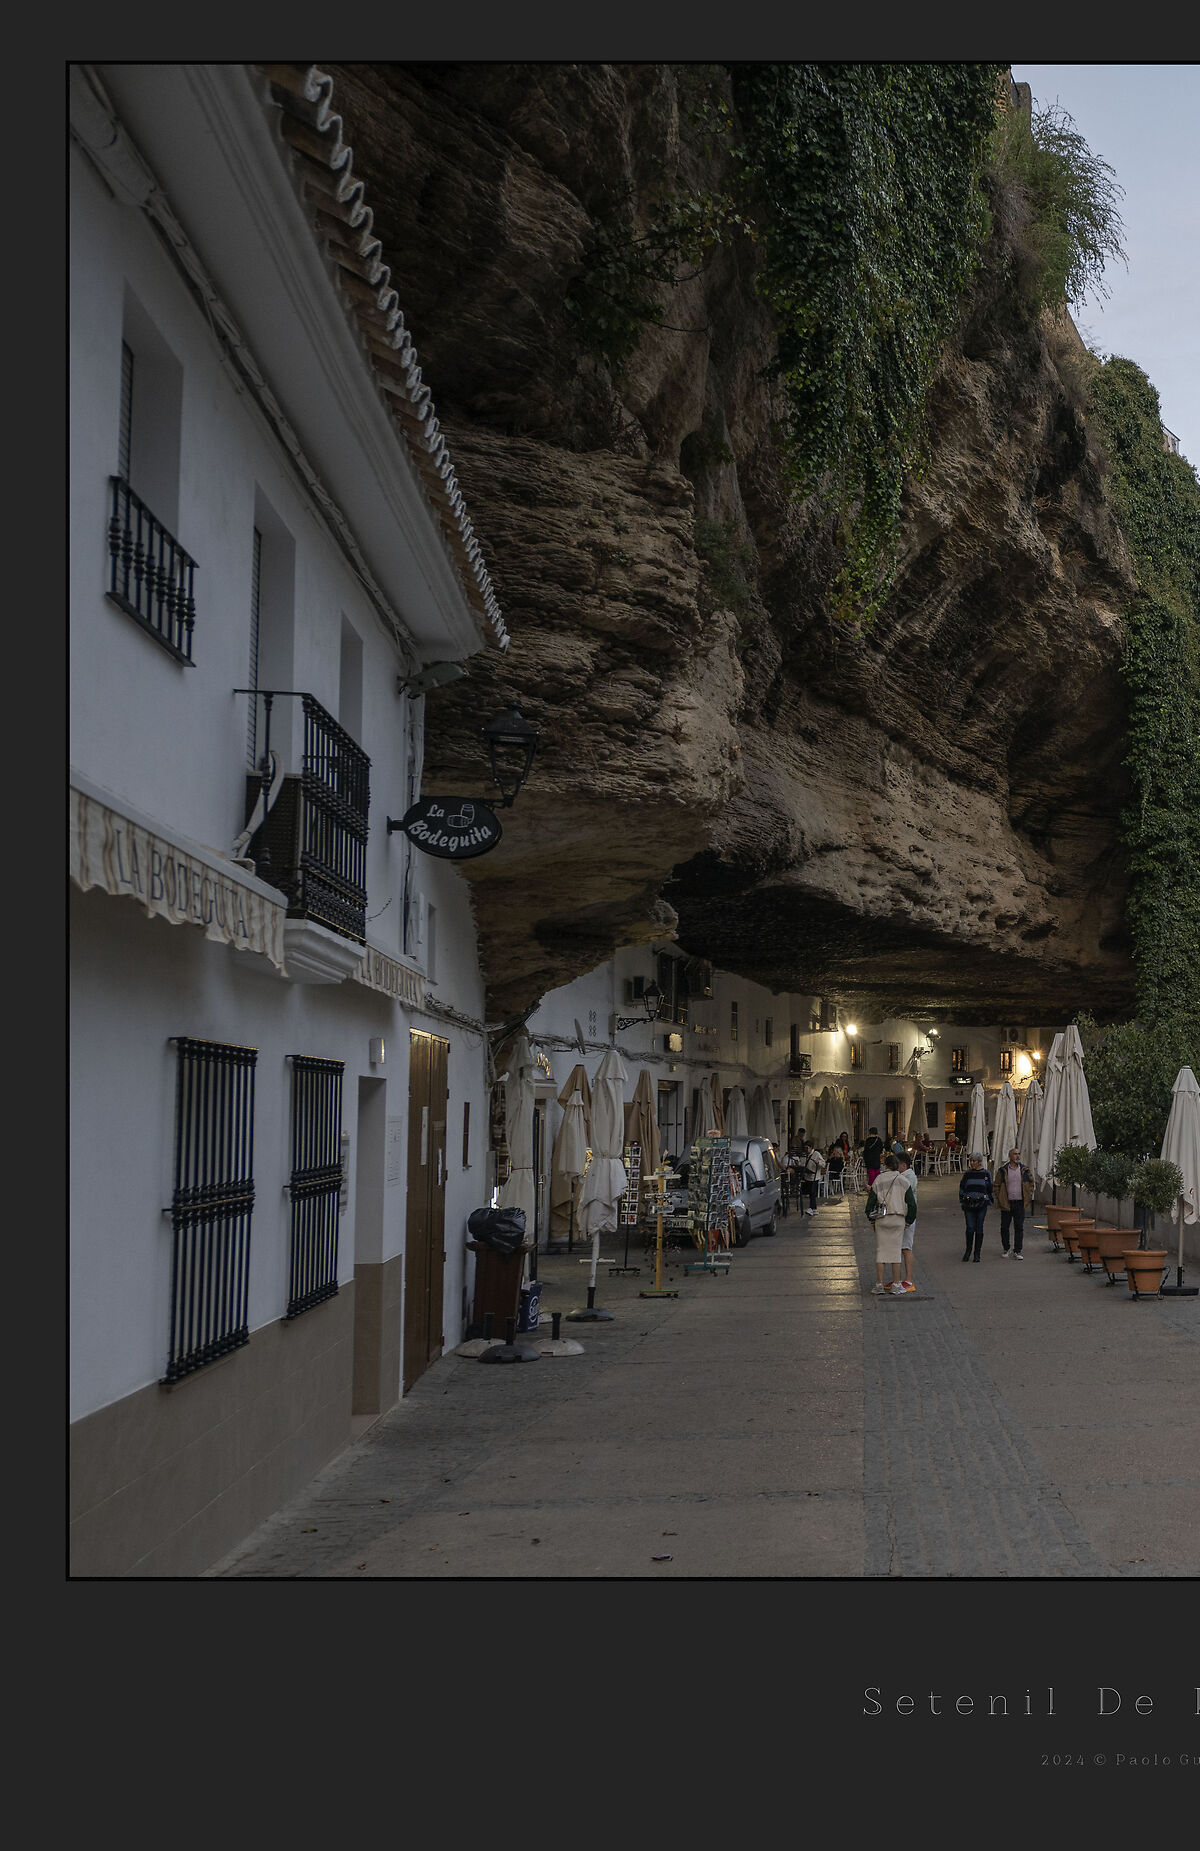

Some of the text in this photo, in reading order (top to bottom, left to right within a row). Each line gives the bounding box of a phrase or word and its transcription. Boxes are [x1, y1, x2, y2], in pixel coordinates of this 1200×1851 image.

[426, 804, 445, 817] La
[407, 819, 492, 852] Bodeguita
[115, 829, 250, 938] LA BODEGUTA
